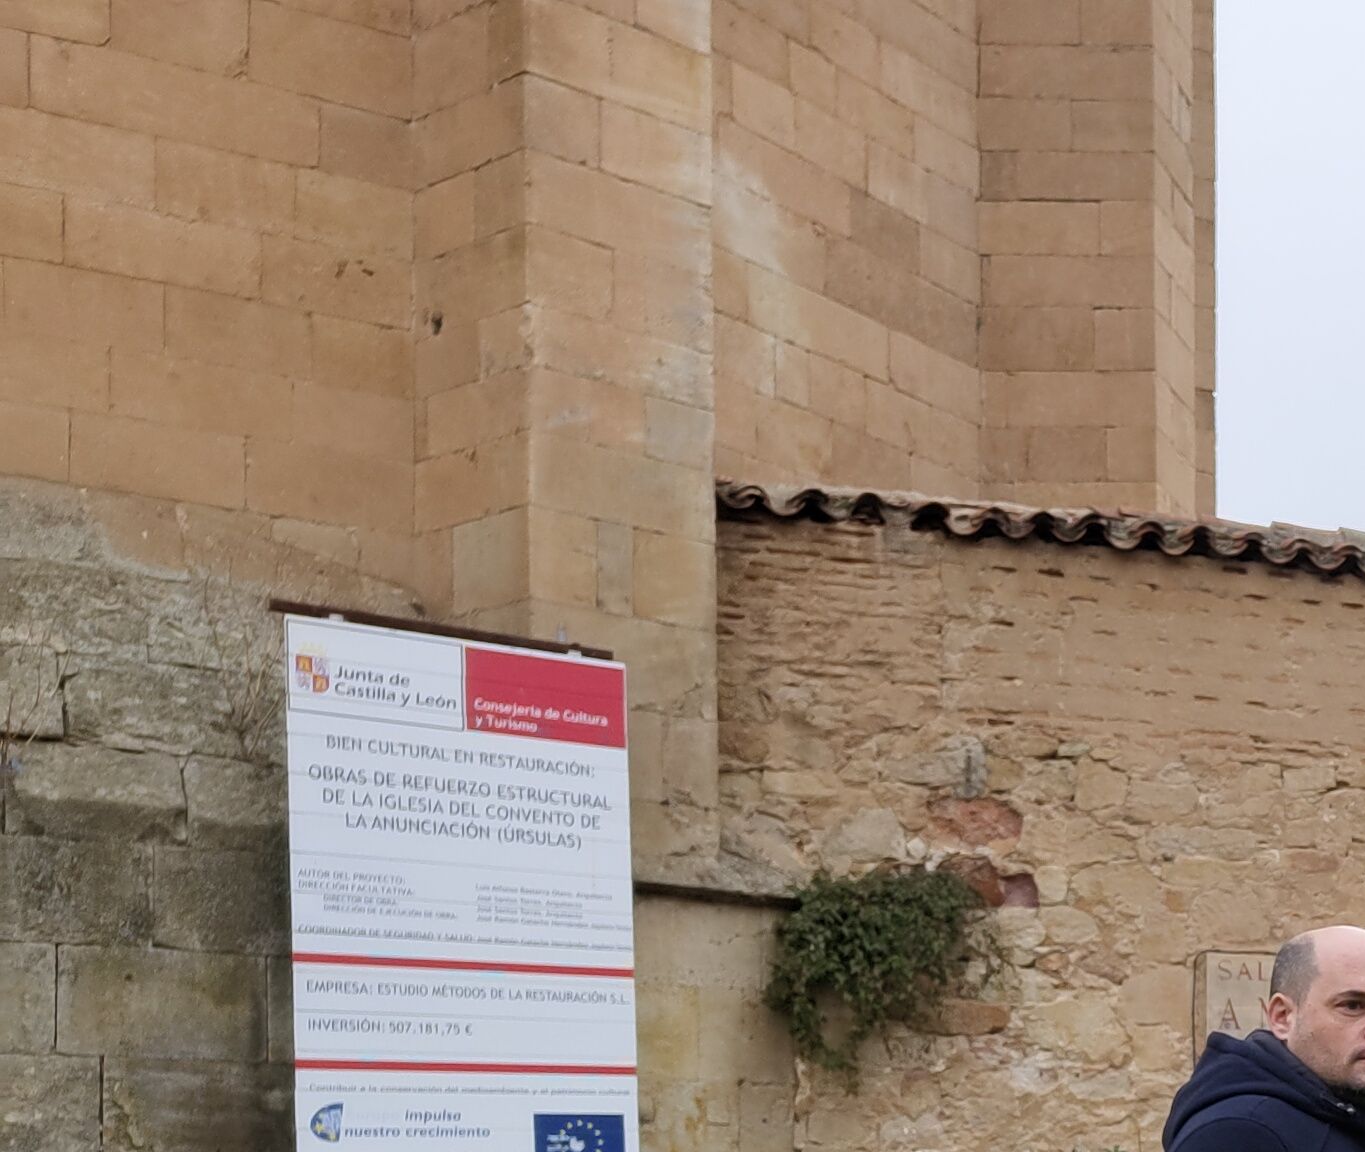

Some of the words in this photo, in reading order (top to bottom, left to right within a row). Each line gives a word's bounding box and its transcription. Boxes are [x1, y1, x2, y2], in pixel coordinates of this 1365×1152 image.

[333, 665, 384, 684] Junta
[389, 673, 410, 688] de
[334, 682, 397, 702] Castilla
[400, 693, 410, 708] y
[416, 692, 457, 710] León
[475, 715, 483, 728] y
[486, 714, 538, 732] Turismo
[544, 706, 560, 720] de
[563, 710, 608, 727] Cultura
[326, 734, 362, 751] BIEN
[368, 739, 450, 762] CULTURAL
[454, 749, 473, 764] EN
[308, 763, 367, 786] OBRAS
[374, 771, 397, 788] DE
[402, 774, 491, 798] REFUERZO
[497, 784, 613, 811] ESTRUCTURAL
[322, 787, 345, 805] DE
[352, 790, 374, 808] LA
[379, 793, 444, 814] IGLESIA
[449, 801, 480, 818] DEL
[486, 804, 575, 828] CONVENTO
[581, 813, 600, 830] DE
[345, 811, 367, 829] LA
[371, 815, 490, 840] ANUNCIACIÓN
[498, 823, 582, 850] (ÚRSULAS)
[1217, 959, 1268, 981] SAL
[306, 979, 373, 996] EMPRESA:
[377, 981, 428, 996] ESTUDIO
[432, 984, 486, 999] MÉTODOS
[490, 987, 503, 1000] DE
[508, 988, 522, 1001] LA
[526, 988, 607, 1003] RESTAURACIÓN
[610, 992, 631, 1005] S.L.
[307, 1017, 385, 1034] INVERSIÓN:
[389, 1020, 460, 1037] 507.181,75
[465, 1022, 473, 1037] €
[404, 1108, 462, 1124] impulsa
[345, 1126, 400, 1138] nuestro
[405, 1125, 491, 1138] crecimiento
